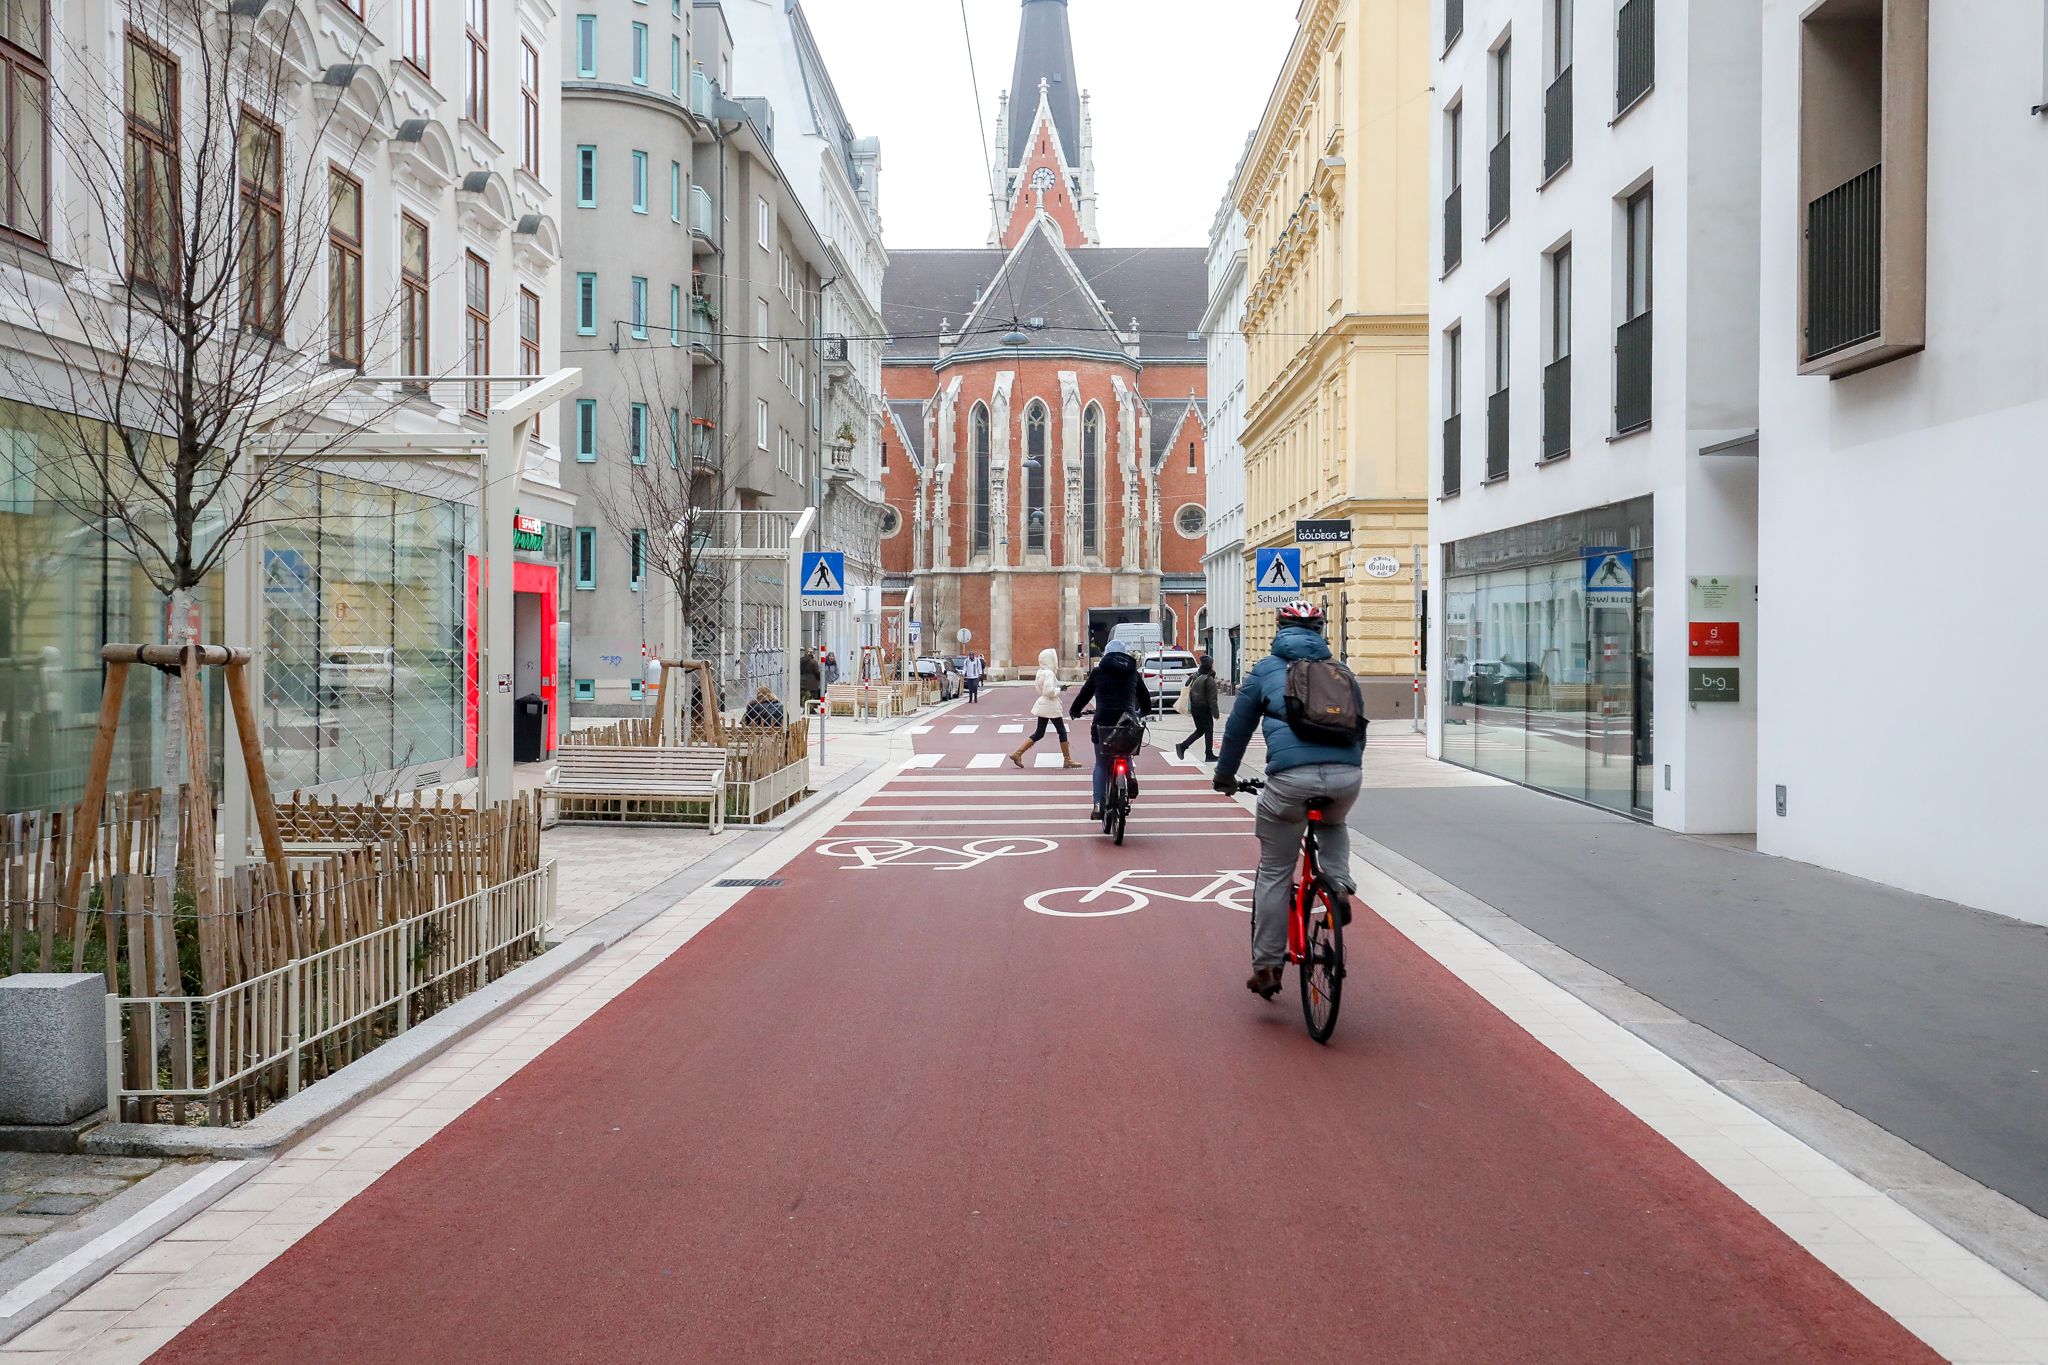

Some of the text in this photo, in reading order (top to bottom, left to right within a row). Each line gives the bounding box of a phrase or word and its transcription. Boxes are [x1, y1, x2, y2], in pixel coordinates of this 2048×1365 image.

[521, 518, 536, 531] SPAR
[1298, 532, 1337, 540] GOLDEGG
[1368, 563, 1397, 573] Goldegg
[802, 598, 843, 608] Schulweg
